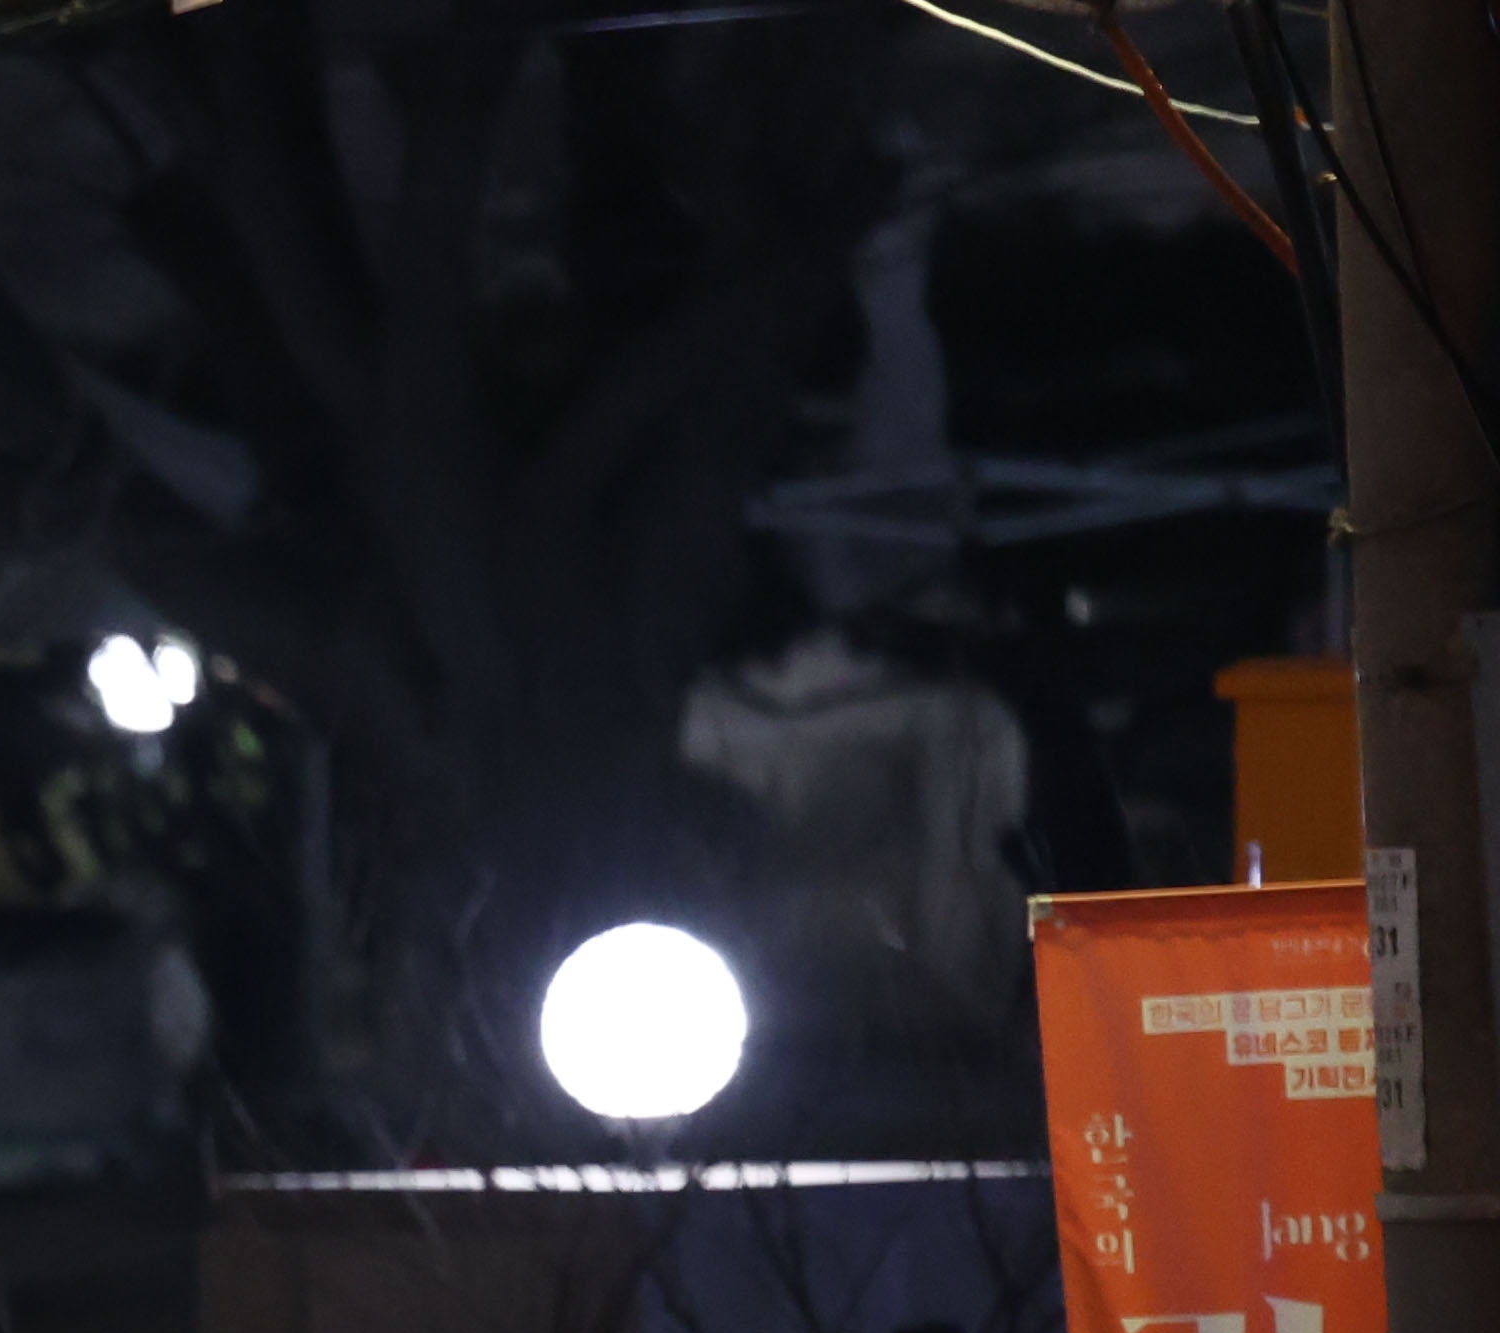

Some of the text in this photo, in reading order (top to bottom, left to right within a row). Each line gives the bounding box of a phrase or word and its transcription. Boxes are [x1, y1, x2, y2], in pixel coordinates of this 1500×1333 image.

[1340, 990, 1376, 1019] 문
[1233, 1029, 1329, 1057] 유네스코
[1083, 1112, 1135, 1274] 한국의
